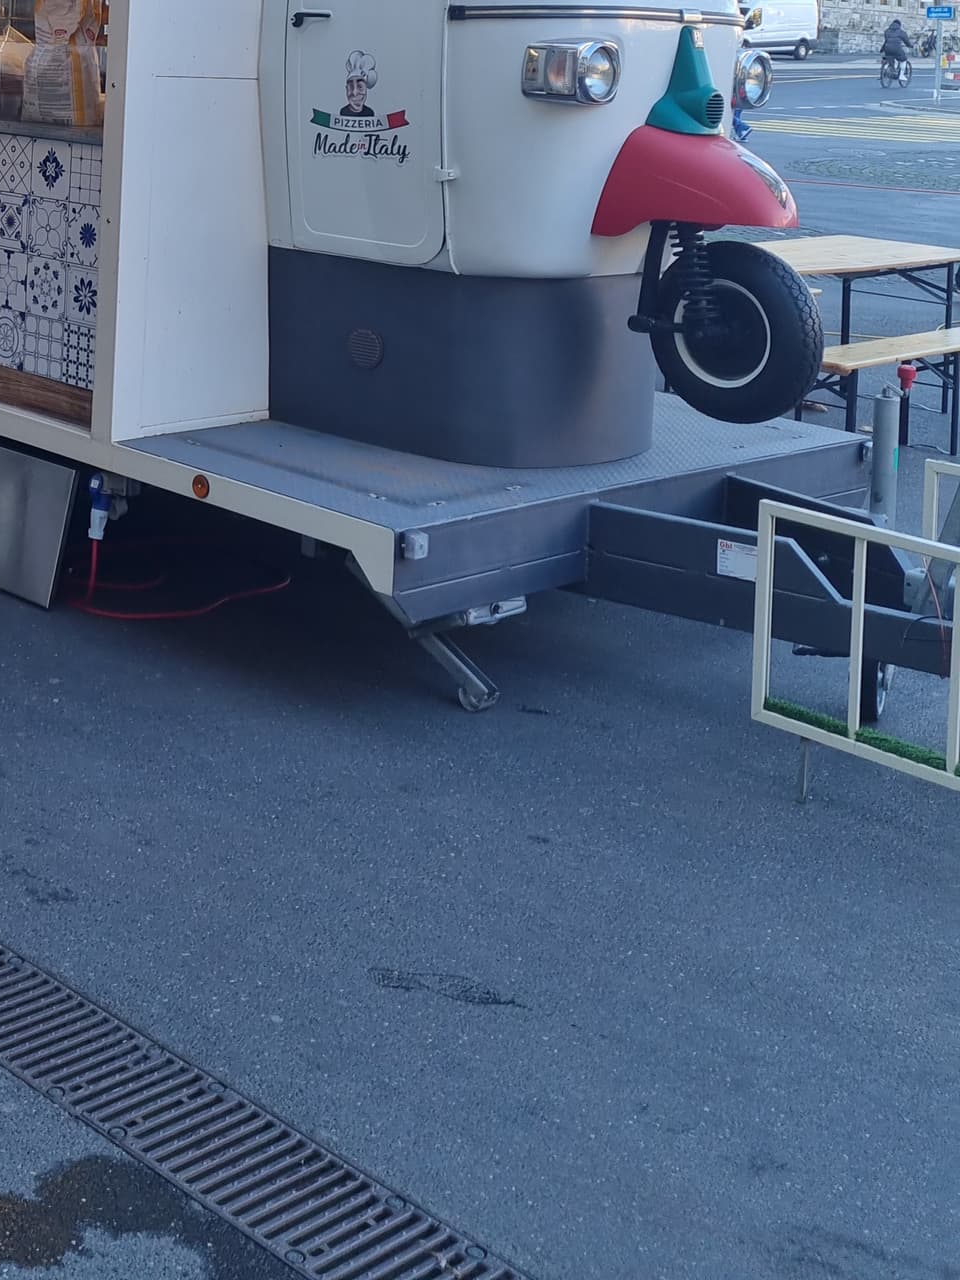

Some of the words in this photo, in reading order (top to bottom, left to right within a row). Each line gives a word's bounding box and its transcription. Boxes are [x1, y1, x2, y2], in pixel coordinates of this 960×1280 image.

[334, 117, 383, 128] PIZZERIA
[314, 132, 359, 155] Made
[357, 139, 366, 150] in
[364, 133, 410, 163] Italy
